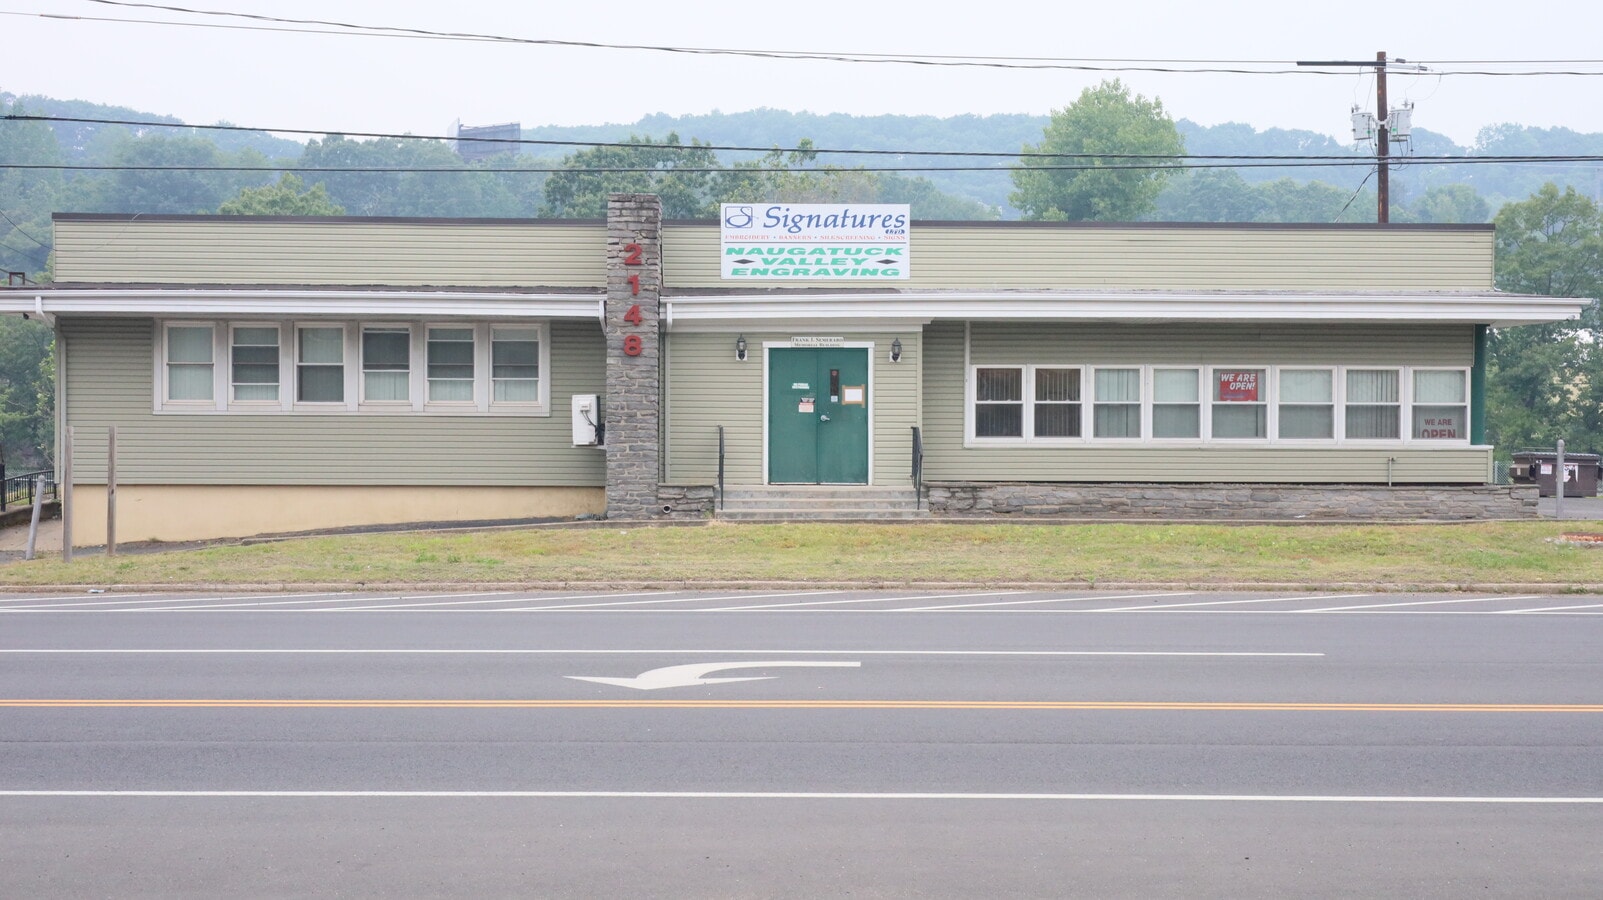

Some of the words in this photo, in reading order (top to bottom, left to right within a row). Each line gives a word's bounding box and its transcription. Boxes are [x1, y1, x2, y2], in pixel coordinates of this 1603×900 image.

[763, 206, 906, 233] Signatures
[725, 247, 904, 256] NAUGATUCK
[761, 257, 870, 266] VALLEY
[731, 268, 901, 277] ENGRAVING
[1221, 373, 1235, 382] WE
[1237, 373, 1256, 382] ARE
[1229, 381, 1256, 390] OPEN!
[1424, 418, 1435, 426] WE
[1437, 418, 1453, 426] ARE
[1421, 428, 1457, 439] OPEN
